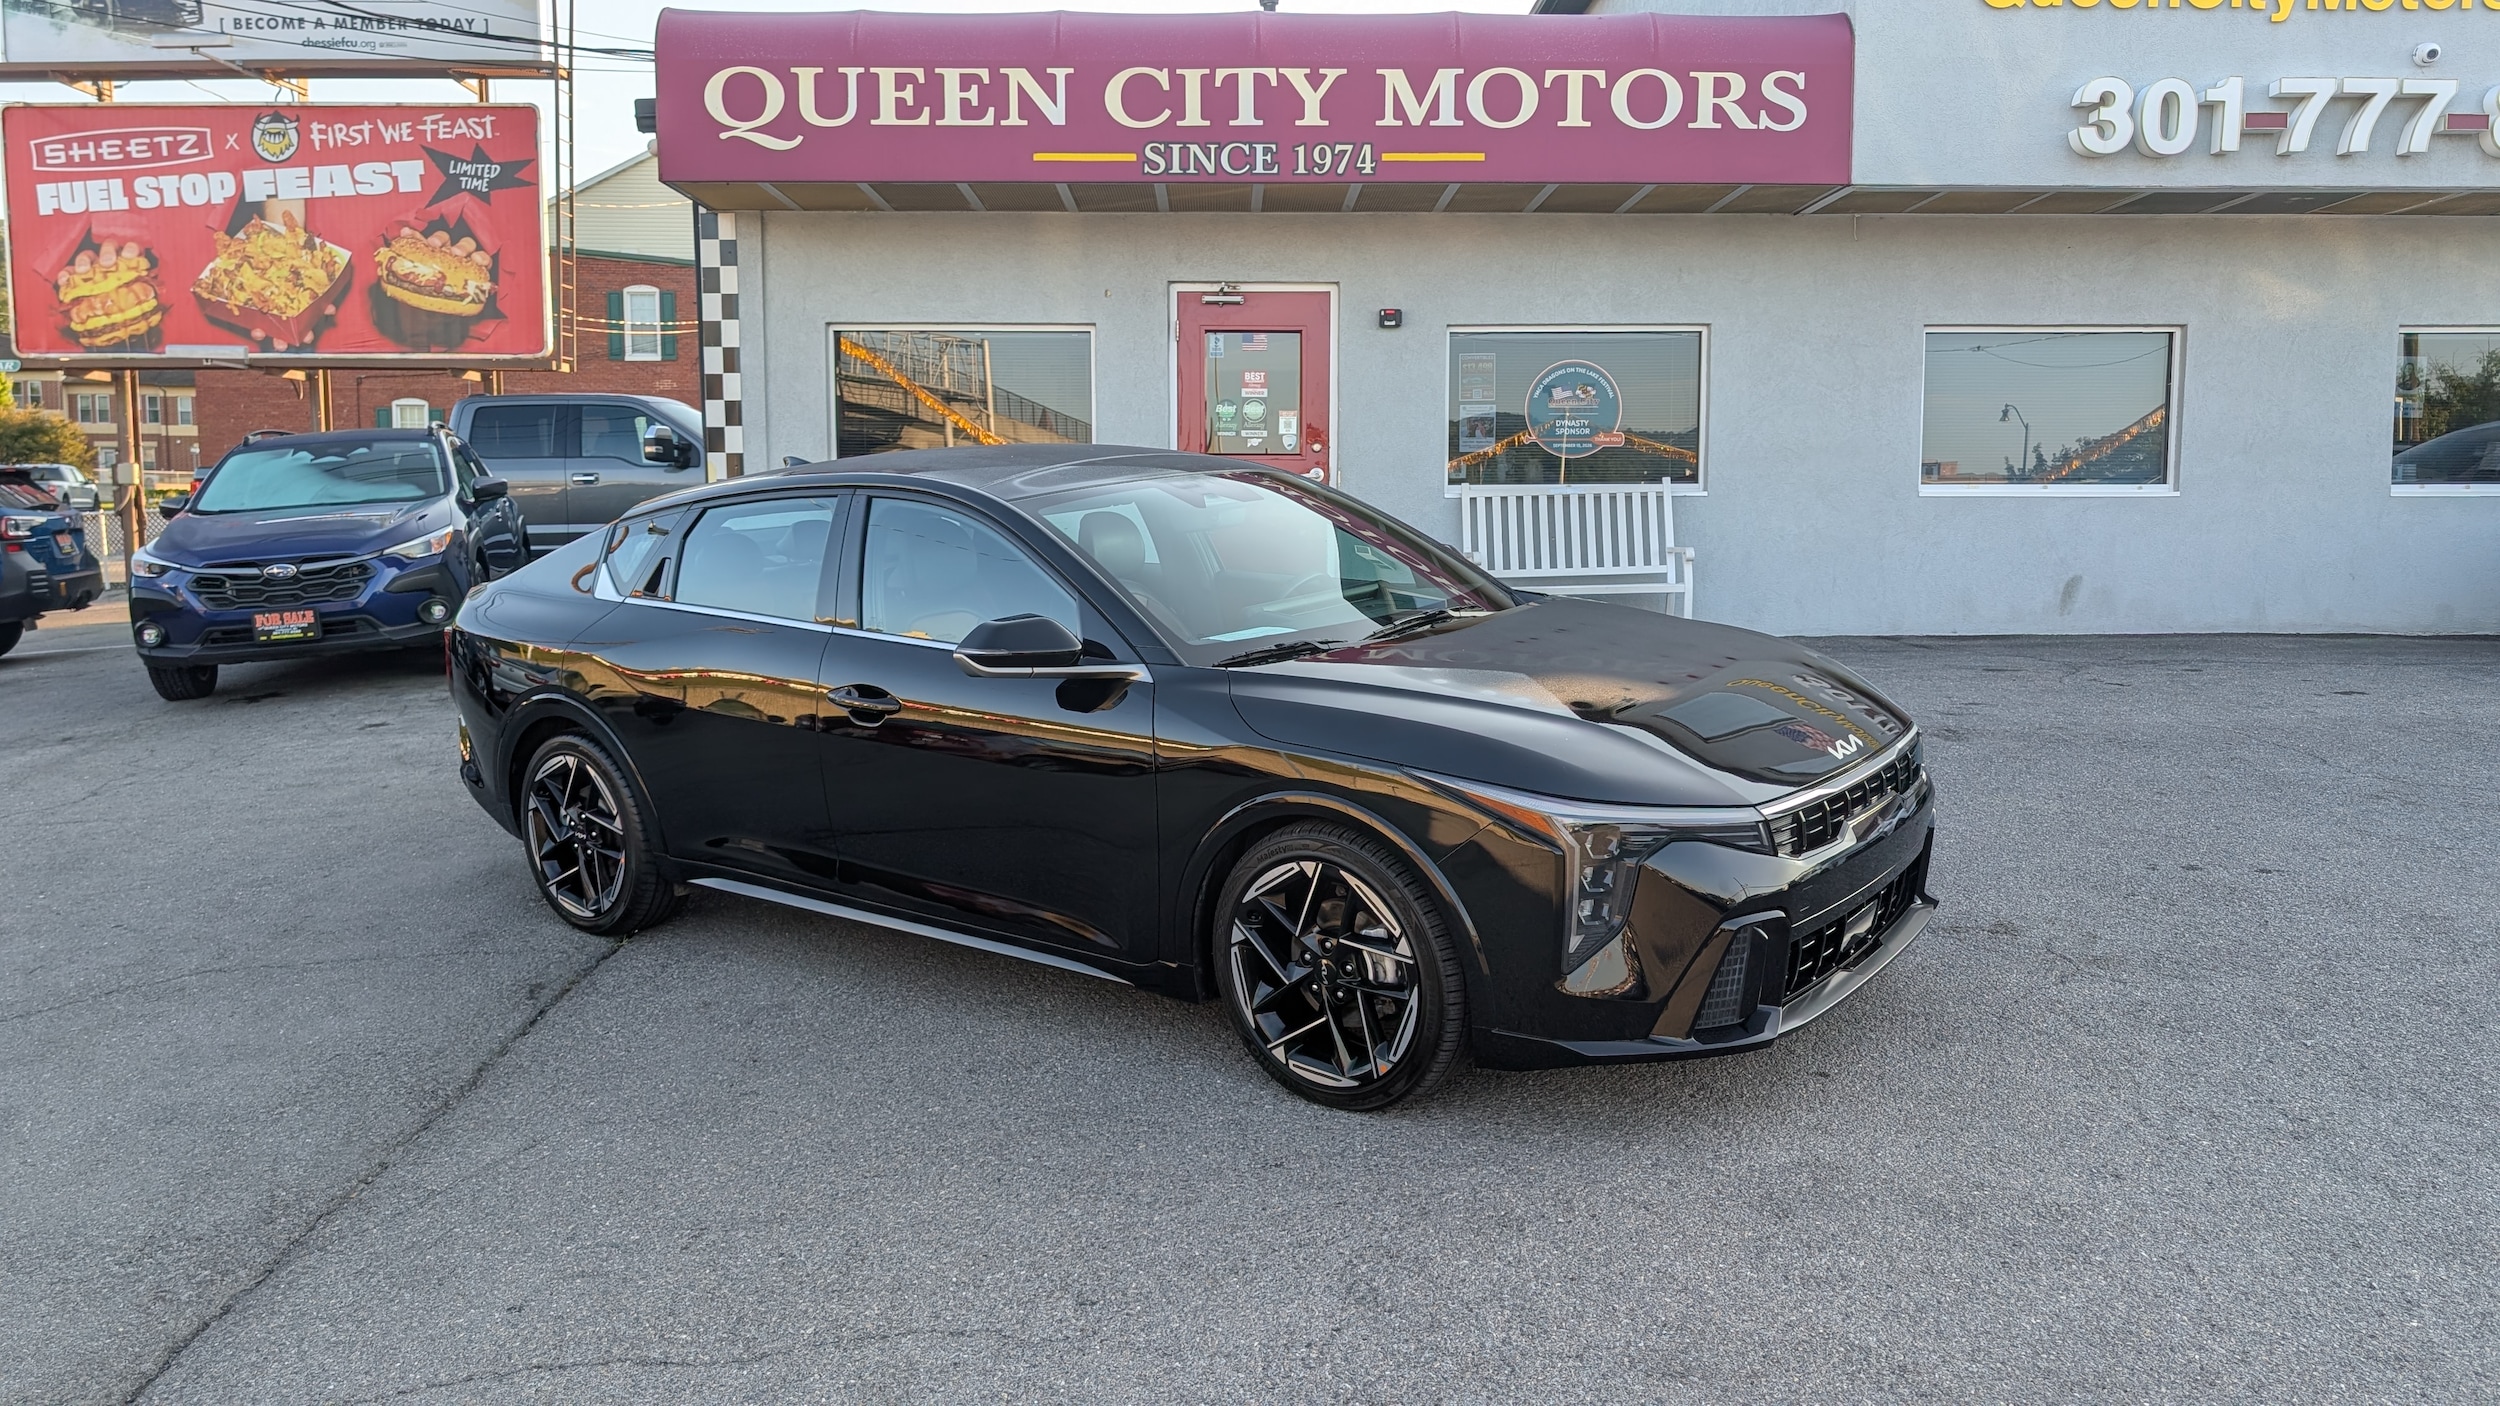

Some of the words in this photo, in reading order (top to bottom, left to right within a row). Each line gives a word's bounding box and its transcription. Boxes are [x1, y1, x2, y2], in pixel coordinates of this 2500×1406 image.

[233, 17, 305, 30] BECOME
[314, 18, 325, 30] A
[334, 17, 408, 31] MEMBER
[417, 18, 476, 32] TODAY
[301, 36, 376, 51] chessiefcu.org
[703, 65, 1075, 151] QUEEN
[1104, 66, 1348, 128] CITY
[1375, 66, 1809, 133] MOTORS
[2067, 75, 2500, 159] 301-777-
[44, 134, 199, 165] SHEETZ
[1142, 141, 1280, 175] SINCE
[1291, 141, 1377, 176] 1974
[449, 159, 501, 179] LIMITED
[36, 178, 130, 216] FUEL
[134, 171, 236, 209] STOP
[242, 159, 426, 203] FEAST
[459, 176, 489, 193] TIME
[1244, 371, 1266, 380] BEST
[1533, 383, 1545, 399] YMCA
[1542, 369, 1566, 386] DRAGONS
[1586, 369, 1600, 380] LAKE
[1597, 377, 1615, 399] FESTIVAL
[1555, 419, 1589, 427] DYNASTY
[254, 612, 282, 628] FOR
[283, 609, 315, 625] SALE
